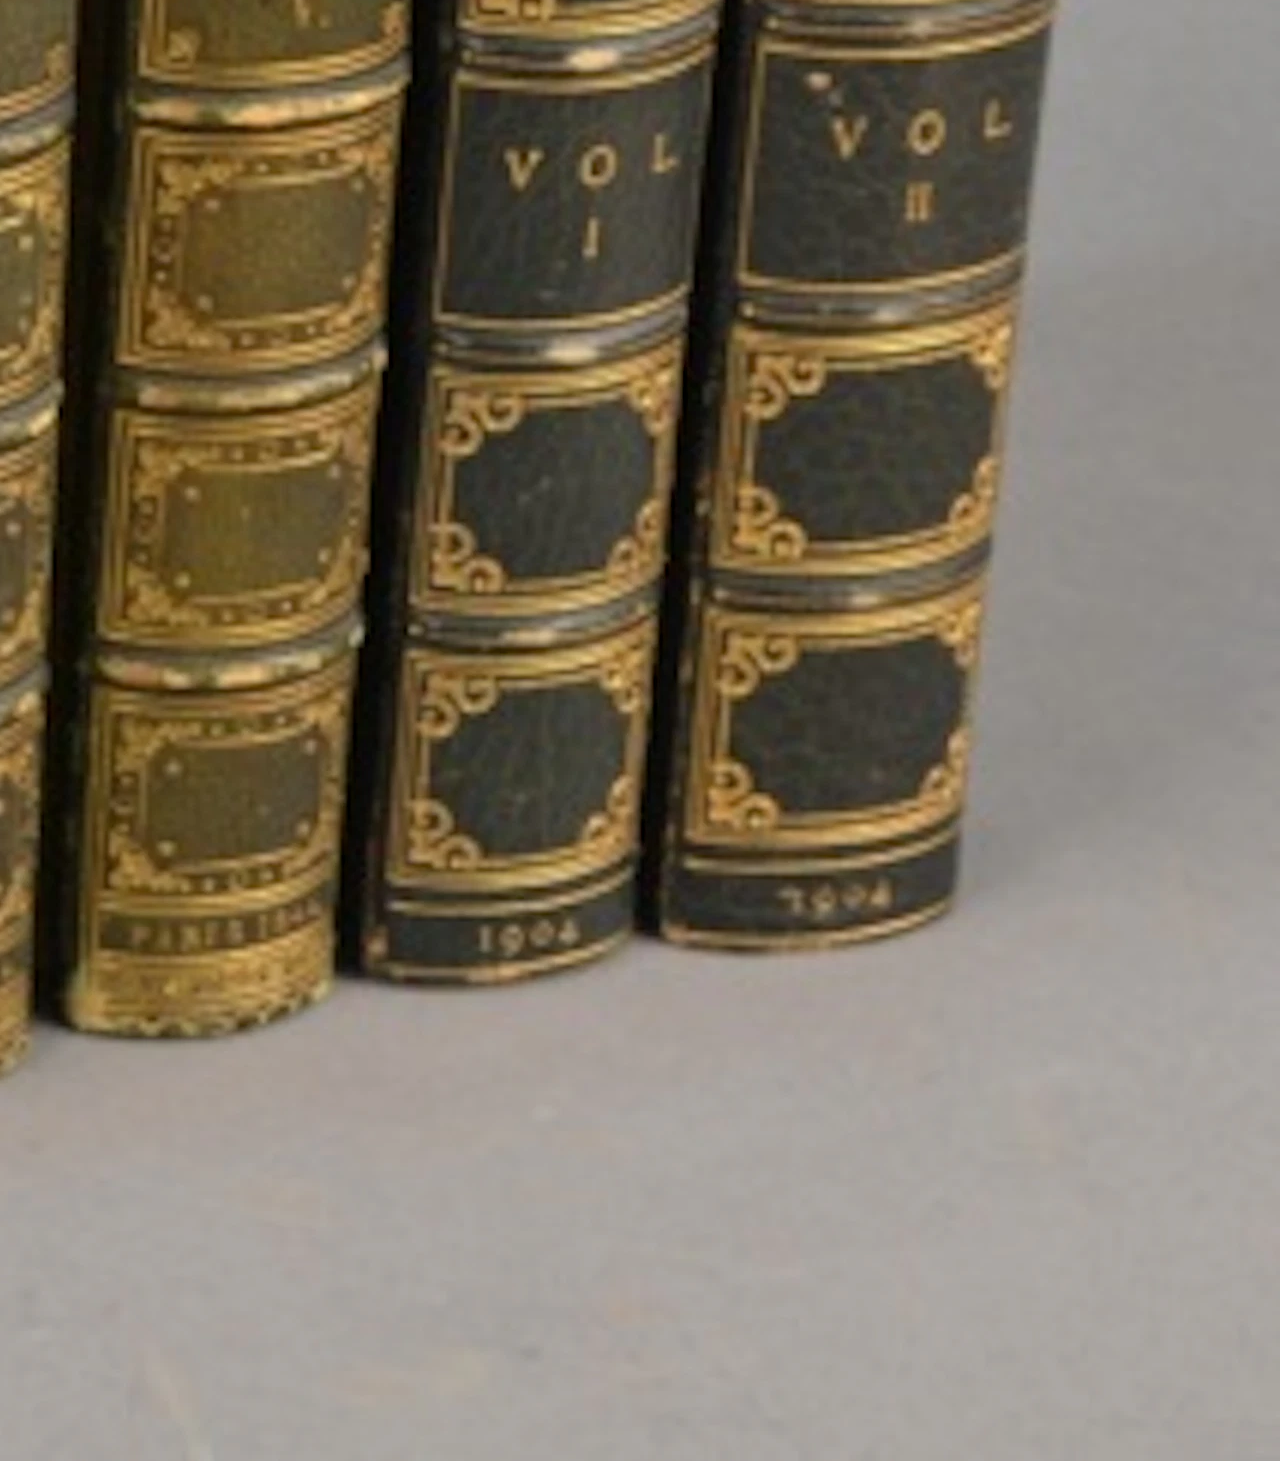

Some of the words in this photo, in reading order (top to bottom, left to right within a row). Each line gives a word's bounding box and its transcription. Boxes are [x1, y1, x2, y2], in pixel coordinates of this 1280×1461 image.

[833, 99, 1013, 160] VOL
[505, 134, 678, 191] VOL
[905, 182, 933, 221] II
[583, 218, 599, 259] I
